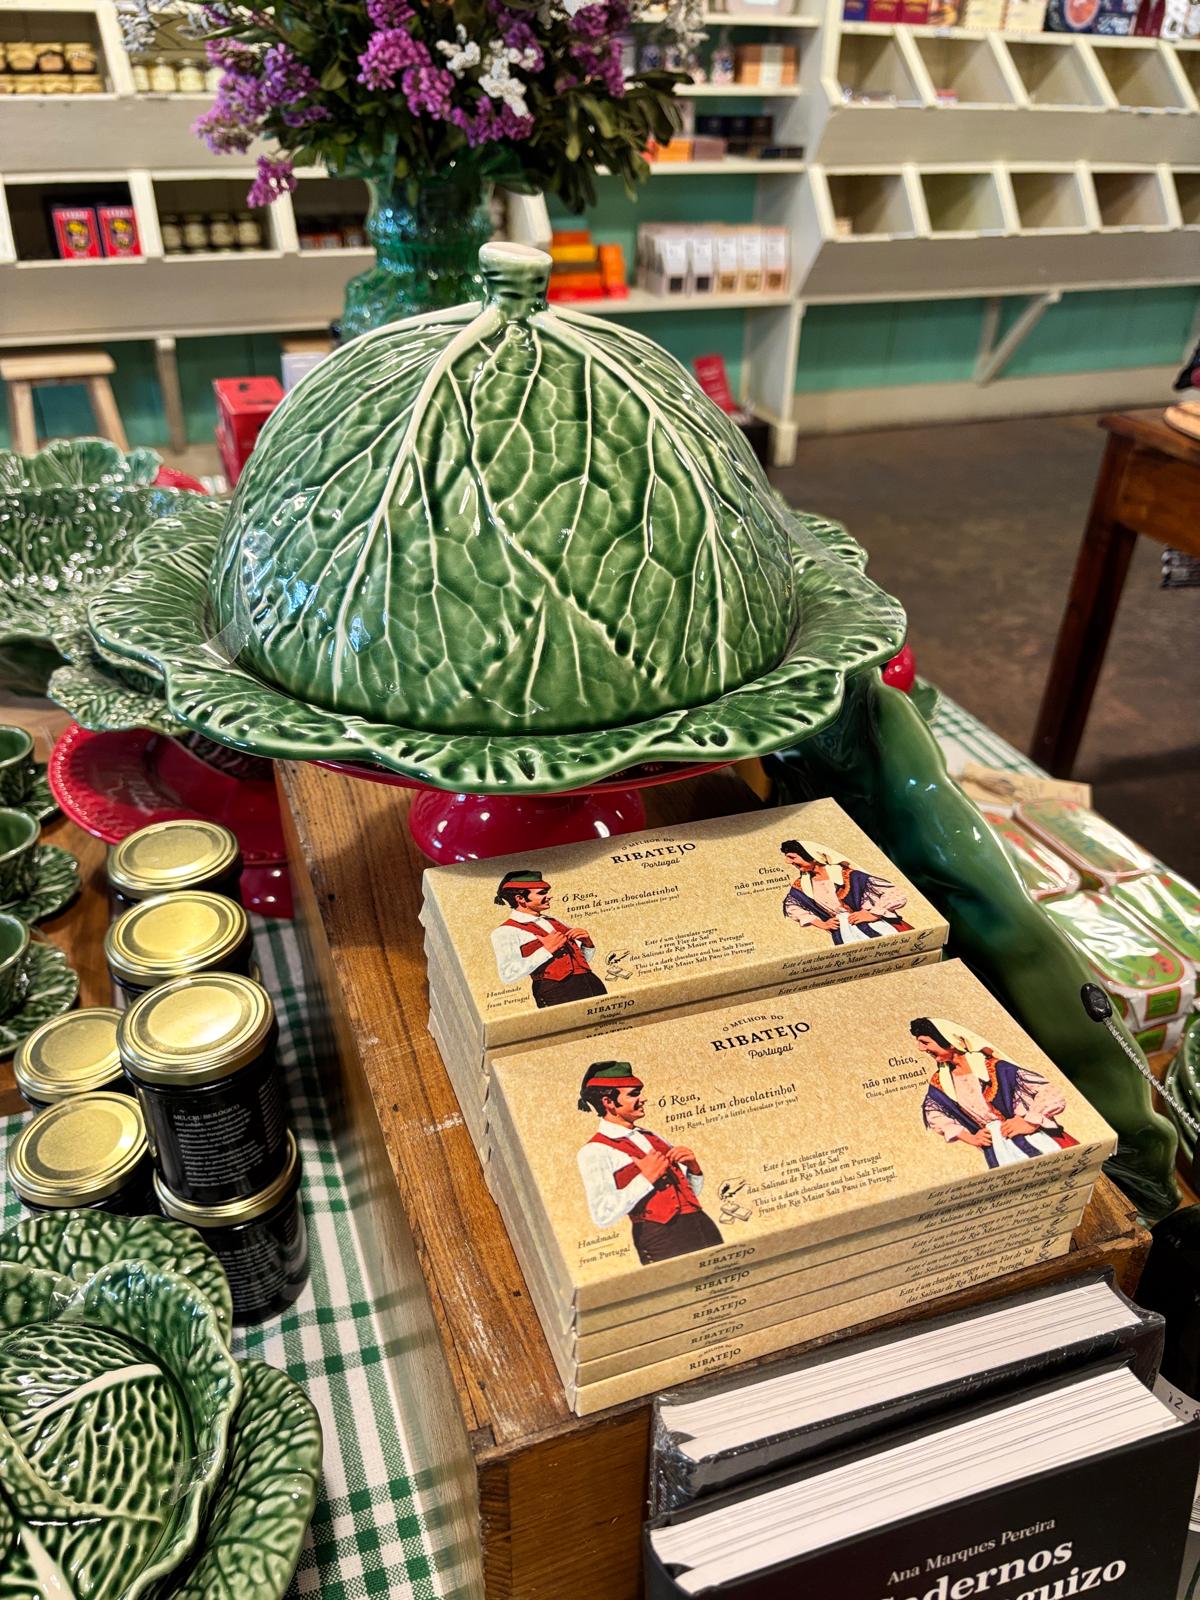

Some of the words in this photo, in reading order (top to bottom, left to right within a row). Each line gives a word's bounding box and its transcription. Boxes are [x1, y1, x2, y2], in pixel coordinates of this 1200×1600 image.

[610, 842, 696, 864] RIBATEJO
[641, 857, 681, 869] Portugal
[758, 866, 784, 875] Chico,
[734, 882, 750, 890] não
[766, 874, 791, 884] moas!
[562, 893, 569, 903] Ó
[573, 891, 598, 902] Rosa,
[567, 903, 590, 913] toma
[592, 899, 602, 908] lá
[604, 898, 619, 906] um
[621, 885, 679, 902] chocolatinho!
[587, 1000, 635, 1015] RIBATEJO
[730, 1015, 767, 1028] MELHOR
[710, 1022, 810, 1051] RIBATEJO
[748, 1043, 794, 1059] Portugal
[888, 1056, 918, 1067] Chico,
[862, 1079, 880, 1090] não
[882, 1076, 897, 1085] me
[899, 1066, 927, 1080] moas!
[658, 1096, 667, 1108] Ó
[670, 1093, 701, 1106] Rosa,
[665, 1110, 693, 1123] toma
[696, 1105, 706, 1115] lá
[709, 1102, 727, 1112] um
[729, 1083, 797, 1107] chocolatinho!
[763, 1163, 778, 1173] Este
[786, 1159, 797, 1167] um
[799, 1150, 829, 1162] chocolate
[830, 1145, 849, 1156] negro
[786, 1166, 800, 1175] tem
[802, 1161, 817, 1171] Flor
[818, 1159, 827, 1167] de
[828, 1154, 840, 1164] Sal
[747, 1186, 760, 1194] das
[761, 1178, 788, 1190] Salinas
[789, 1175, 798, 1184] de
[800, 1171, 813, 1181] Rio
[815, 1164, 838, 1176] Maior
[839, 1162, 850, 1170] em
[851, 1151, 882, 1167] Portugal
[578, 1231, 620, 1249] Handmade
[578, 1256, 597, 1268] from
[599, 1243, 630, 1260] Portugal
[699, 1247, 756, 1268] RIBATEJO
[695, 1270, 750, 1292] RIBATEJO
[693, 1298, 747, 1319] RIBATEJO
[691, 1323, 744, 1344] RIBATEJO
[689, 1348, 741, 1370] RIBATEJO
[887, 1564, 920, 1586] Ana
[924, 1539, 996, 1572] Marques
[1000, 1519, 1057, 1546] Pereira
[880, 1541, 1073, 1600] dernos
